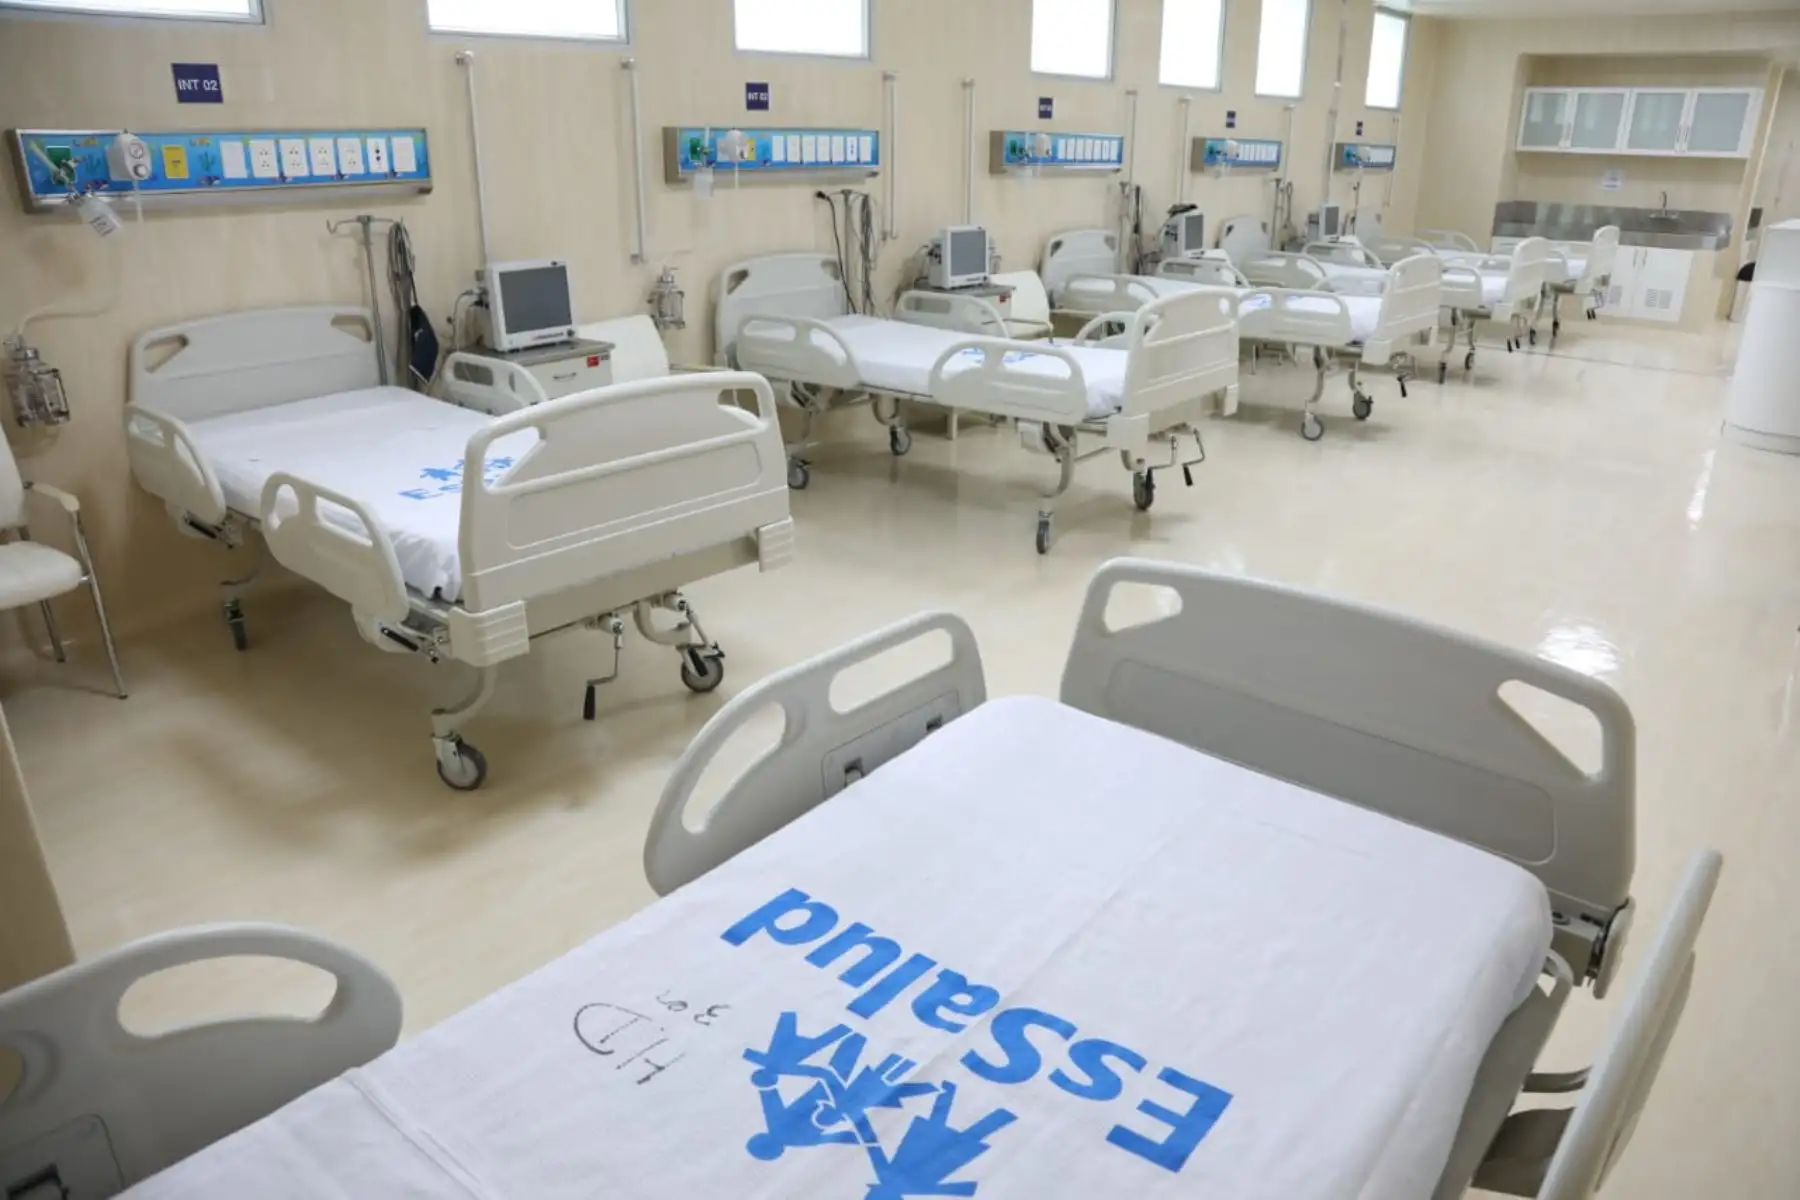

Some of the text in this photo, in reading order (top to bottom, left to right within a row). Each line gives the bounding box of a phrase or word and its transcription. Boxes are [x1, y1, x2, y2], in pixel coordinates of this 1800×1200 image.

[178, 79, 219, 91] INT 02
[721, 888, 1232, 1173] EsSalud
